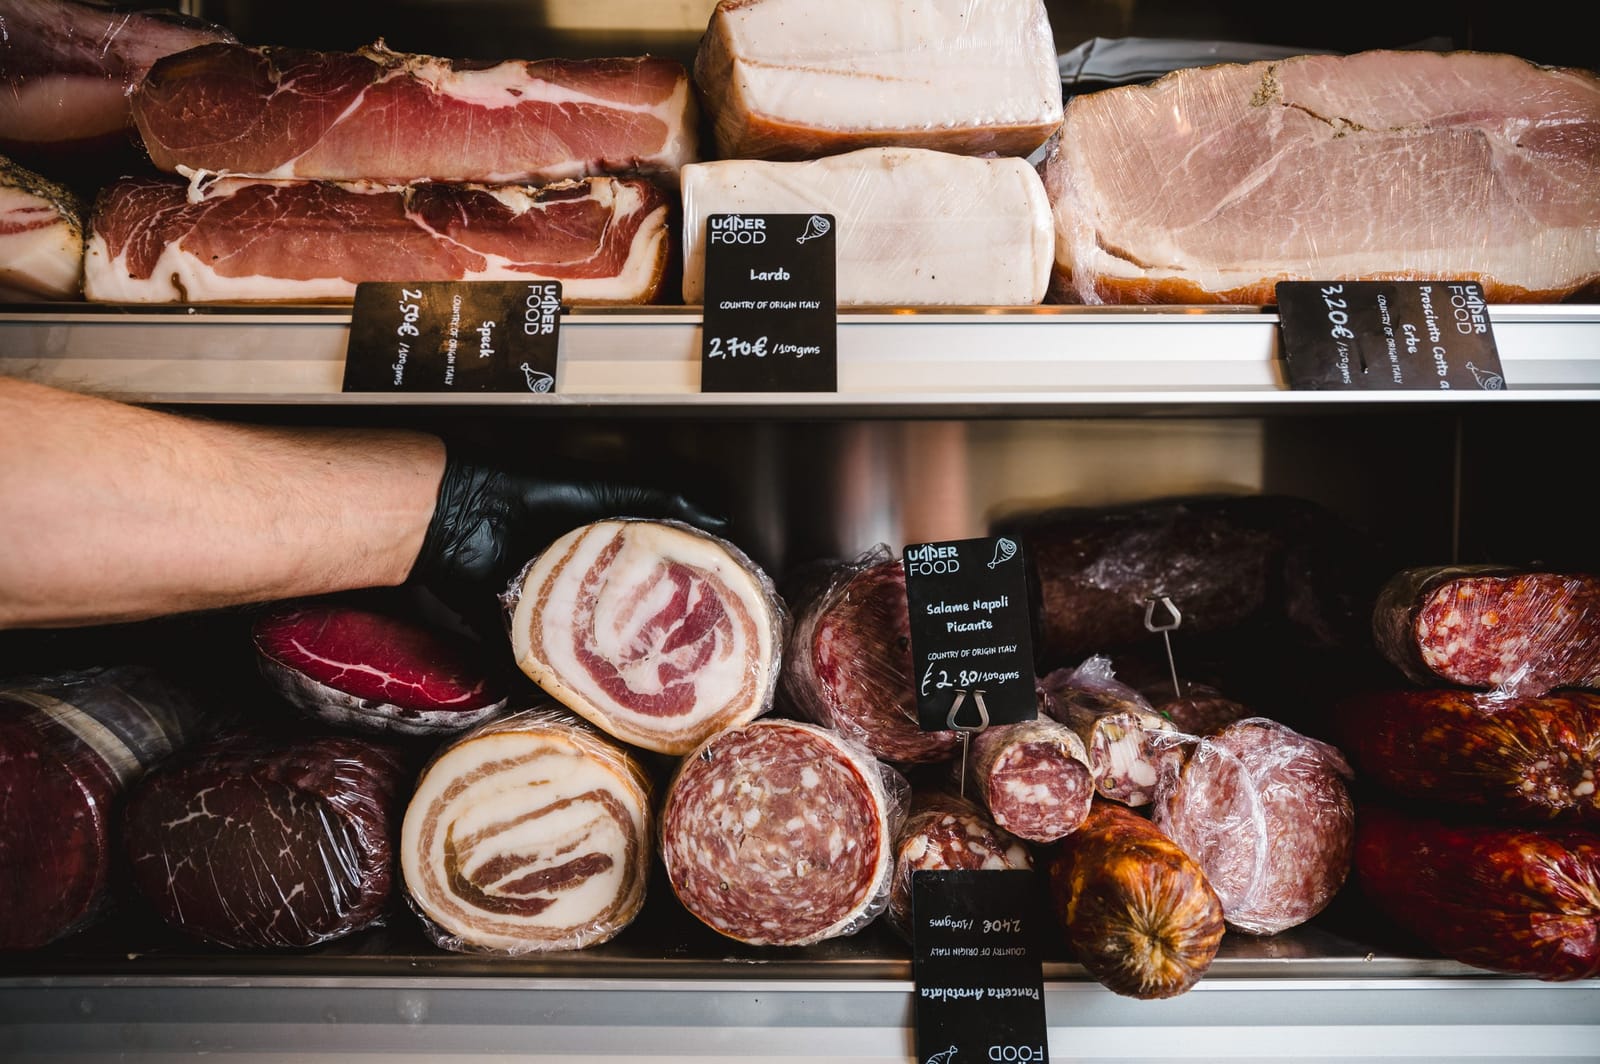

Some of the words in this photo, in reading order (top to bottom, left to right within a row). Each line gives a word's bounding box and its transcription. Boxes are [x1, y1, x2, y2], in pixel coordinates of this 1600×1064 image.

[711, 214, 766, 231] UPPER
[711, 231, 766, 244] FOOD
[750, 267, 791, 281] Lardo
[396, 288, 423, 337] 2,50€
[451, 294, 462, 325] COUNTRY
[524, 285, 541, 335] FOOD
[719, 301, 754, 310] COUNTRY
[756, 301, 767, 310] OF
[769, 301, 797, 310] ORIGIN
[799, 301, 821, 310] ITALY
[1320, 284, 1355, 339] 3,20€
[1376, 294, 1392, 325] COUNTRY
[1448, 285, 1472, 335] FOOD
[449, 325, 459, 338] OF
[476, 320, 496, 358] Speck
[1383, 326, 1394, 337] OF
[1402, 323, 1420, 354] Erbe
[1418, 285, 1441, 343] Prosciutto
[1431, 346, 1449, 377] Cotto
[446, 338, 458, 364] ORIGIN
[708, 336, 768, 359] 2,70€
[772, 343, 821, 358] /100gms
[1385, 337, 1398, 363] ORIGIN
[444, 365, 456, 386] ITALY
[1390, 364, 1404, 384] ITALY
[908, 543, 959, 562] UPPER
[909, 559, 960, 576] FOOD
[926, 601, 970, 615] Salame
[973, 595, 1009, 613] Napoli
[946, 619, 993, 632] Piccante
[927, 650, 959, 661] COUNTRY
[961, 649, 971, 658] OF
[971, 646, 996, 656] ORIGIN
[998, 644, 1018, 654] ITALY
[930, 947, 951, 956] ITALY
[952, 948, 979, 956] ORIGIN
[980, 948, 991, 956] OF
[992, 948, 1026, 956] COUNTRY
[921, 987, 985, 1002] Arrotolata
[987, 987, 1040, 1000] Pancetta
[988, 1045, 1043, 1061] FOOD
